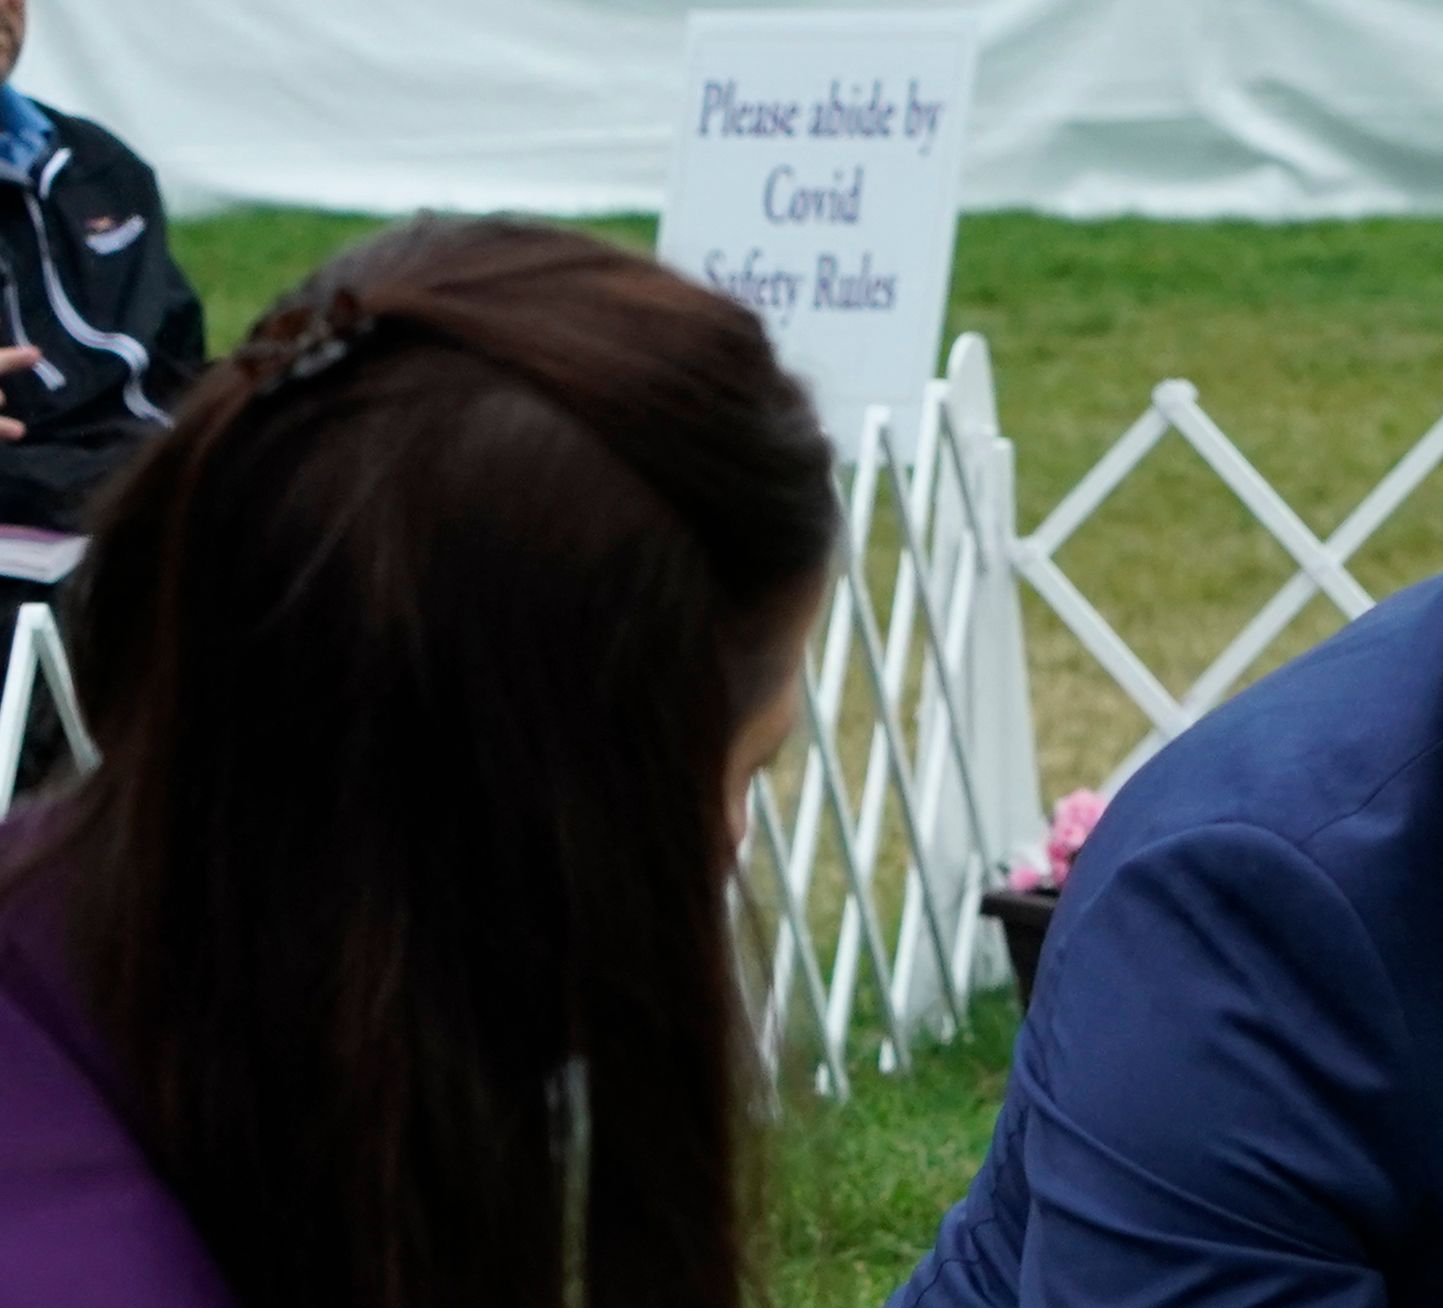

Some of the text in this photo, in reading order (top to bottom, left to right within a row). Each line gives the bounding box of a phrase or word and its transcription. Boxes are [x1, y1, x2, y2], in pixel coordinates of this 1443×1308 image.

[698, 78, 942, 155] Please abide by
[763, 163, 865, 224] Covid
[813, 252, 897, 312] Rules
